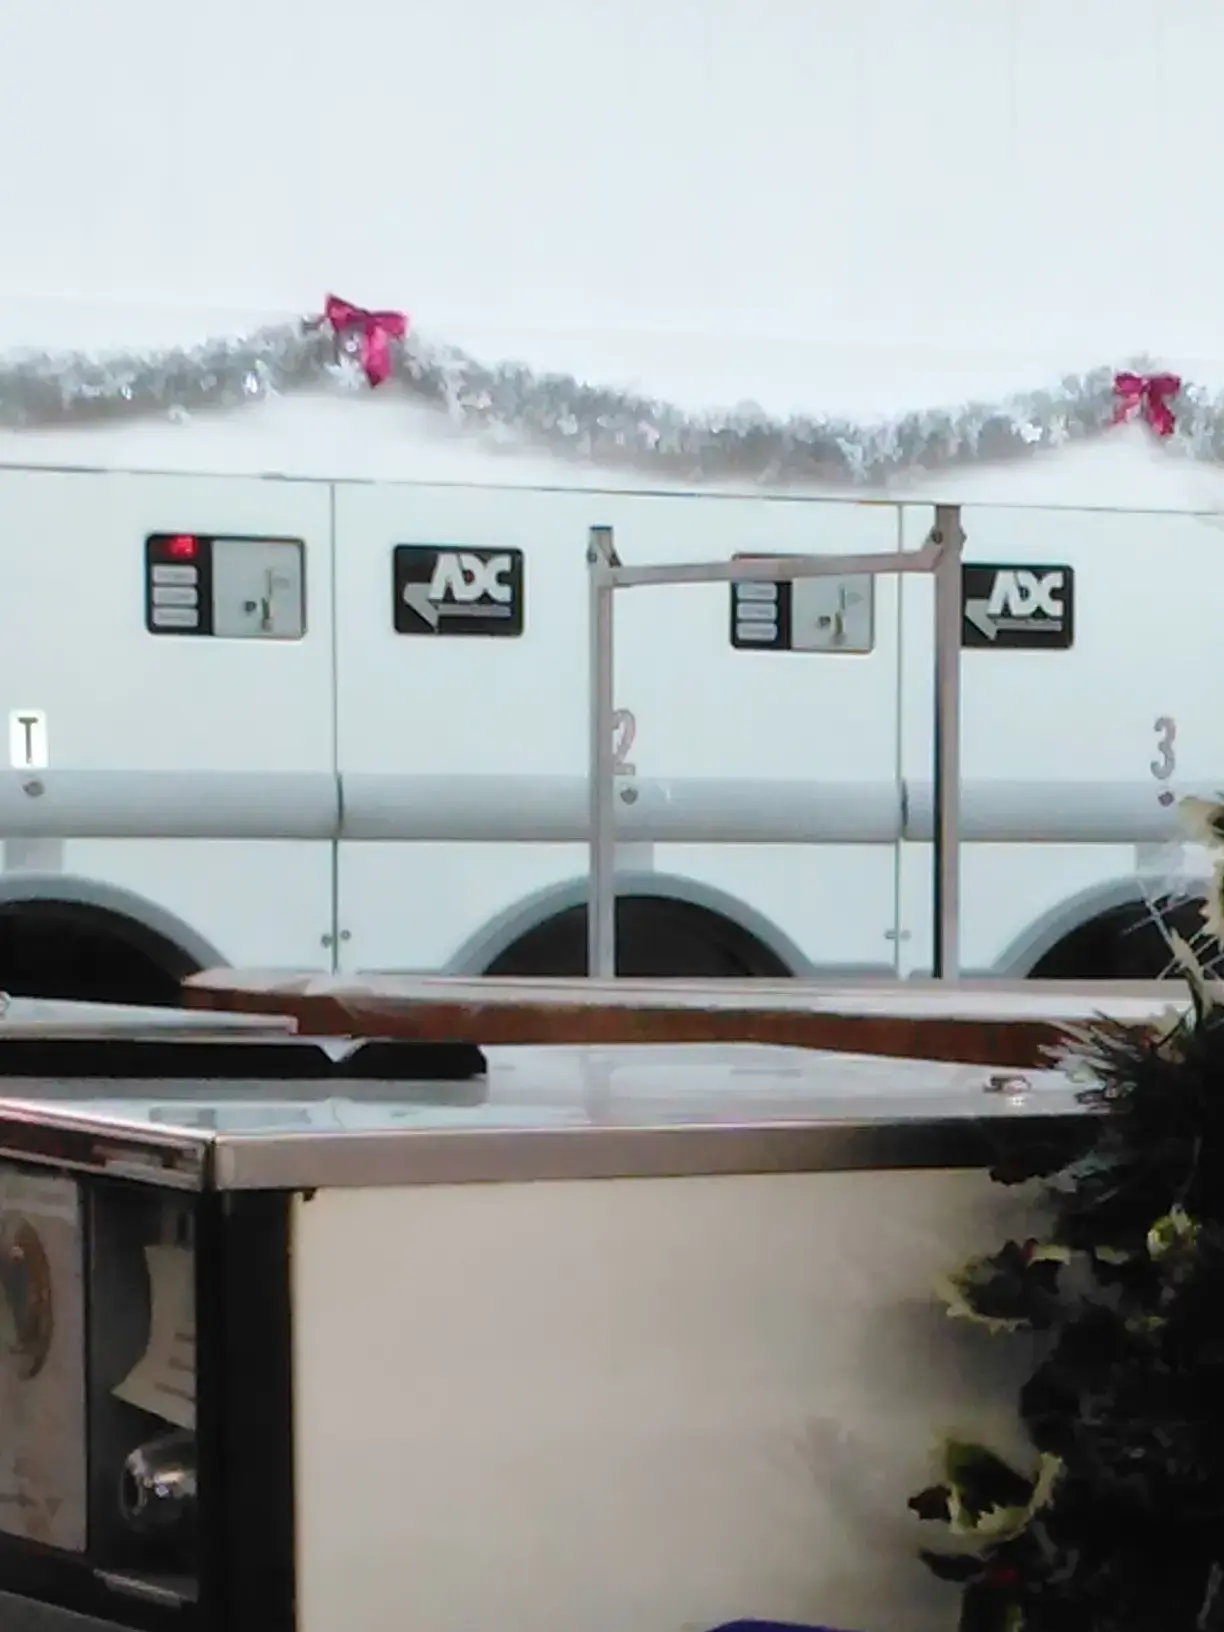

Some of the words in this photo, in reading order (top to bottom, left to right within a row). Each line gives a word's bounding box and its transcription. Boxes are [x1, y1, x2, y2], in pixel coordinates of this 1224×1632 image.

[427, 552, 513, 603] ADC
[985, 568, 1066, 618] ADC
[610, 708, 637, 776] 2
[1149, 716, 1177, 780] 3
